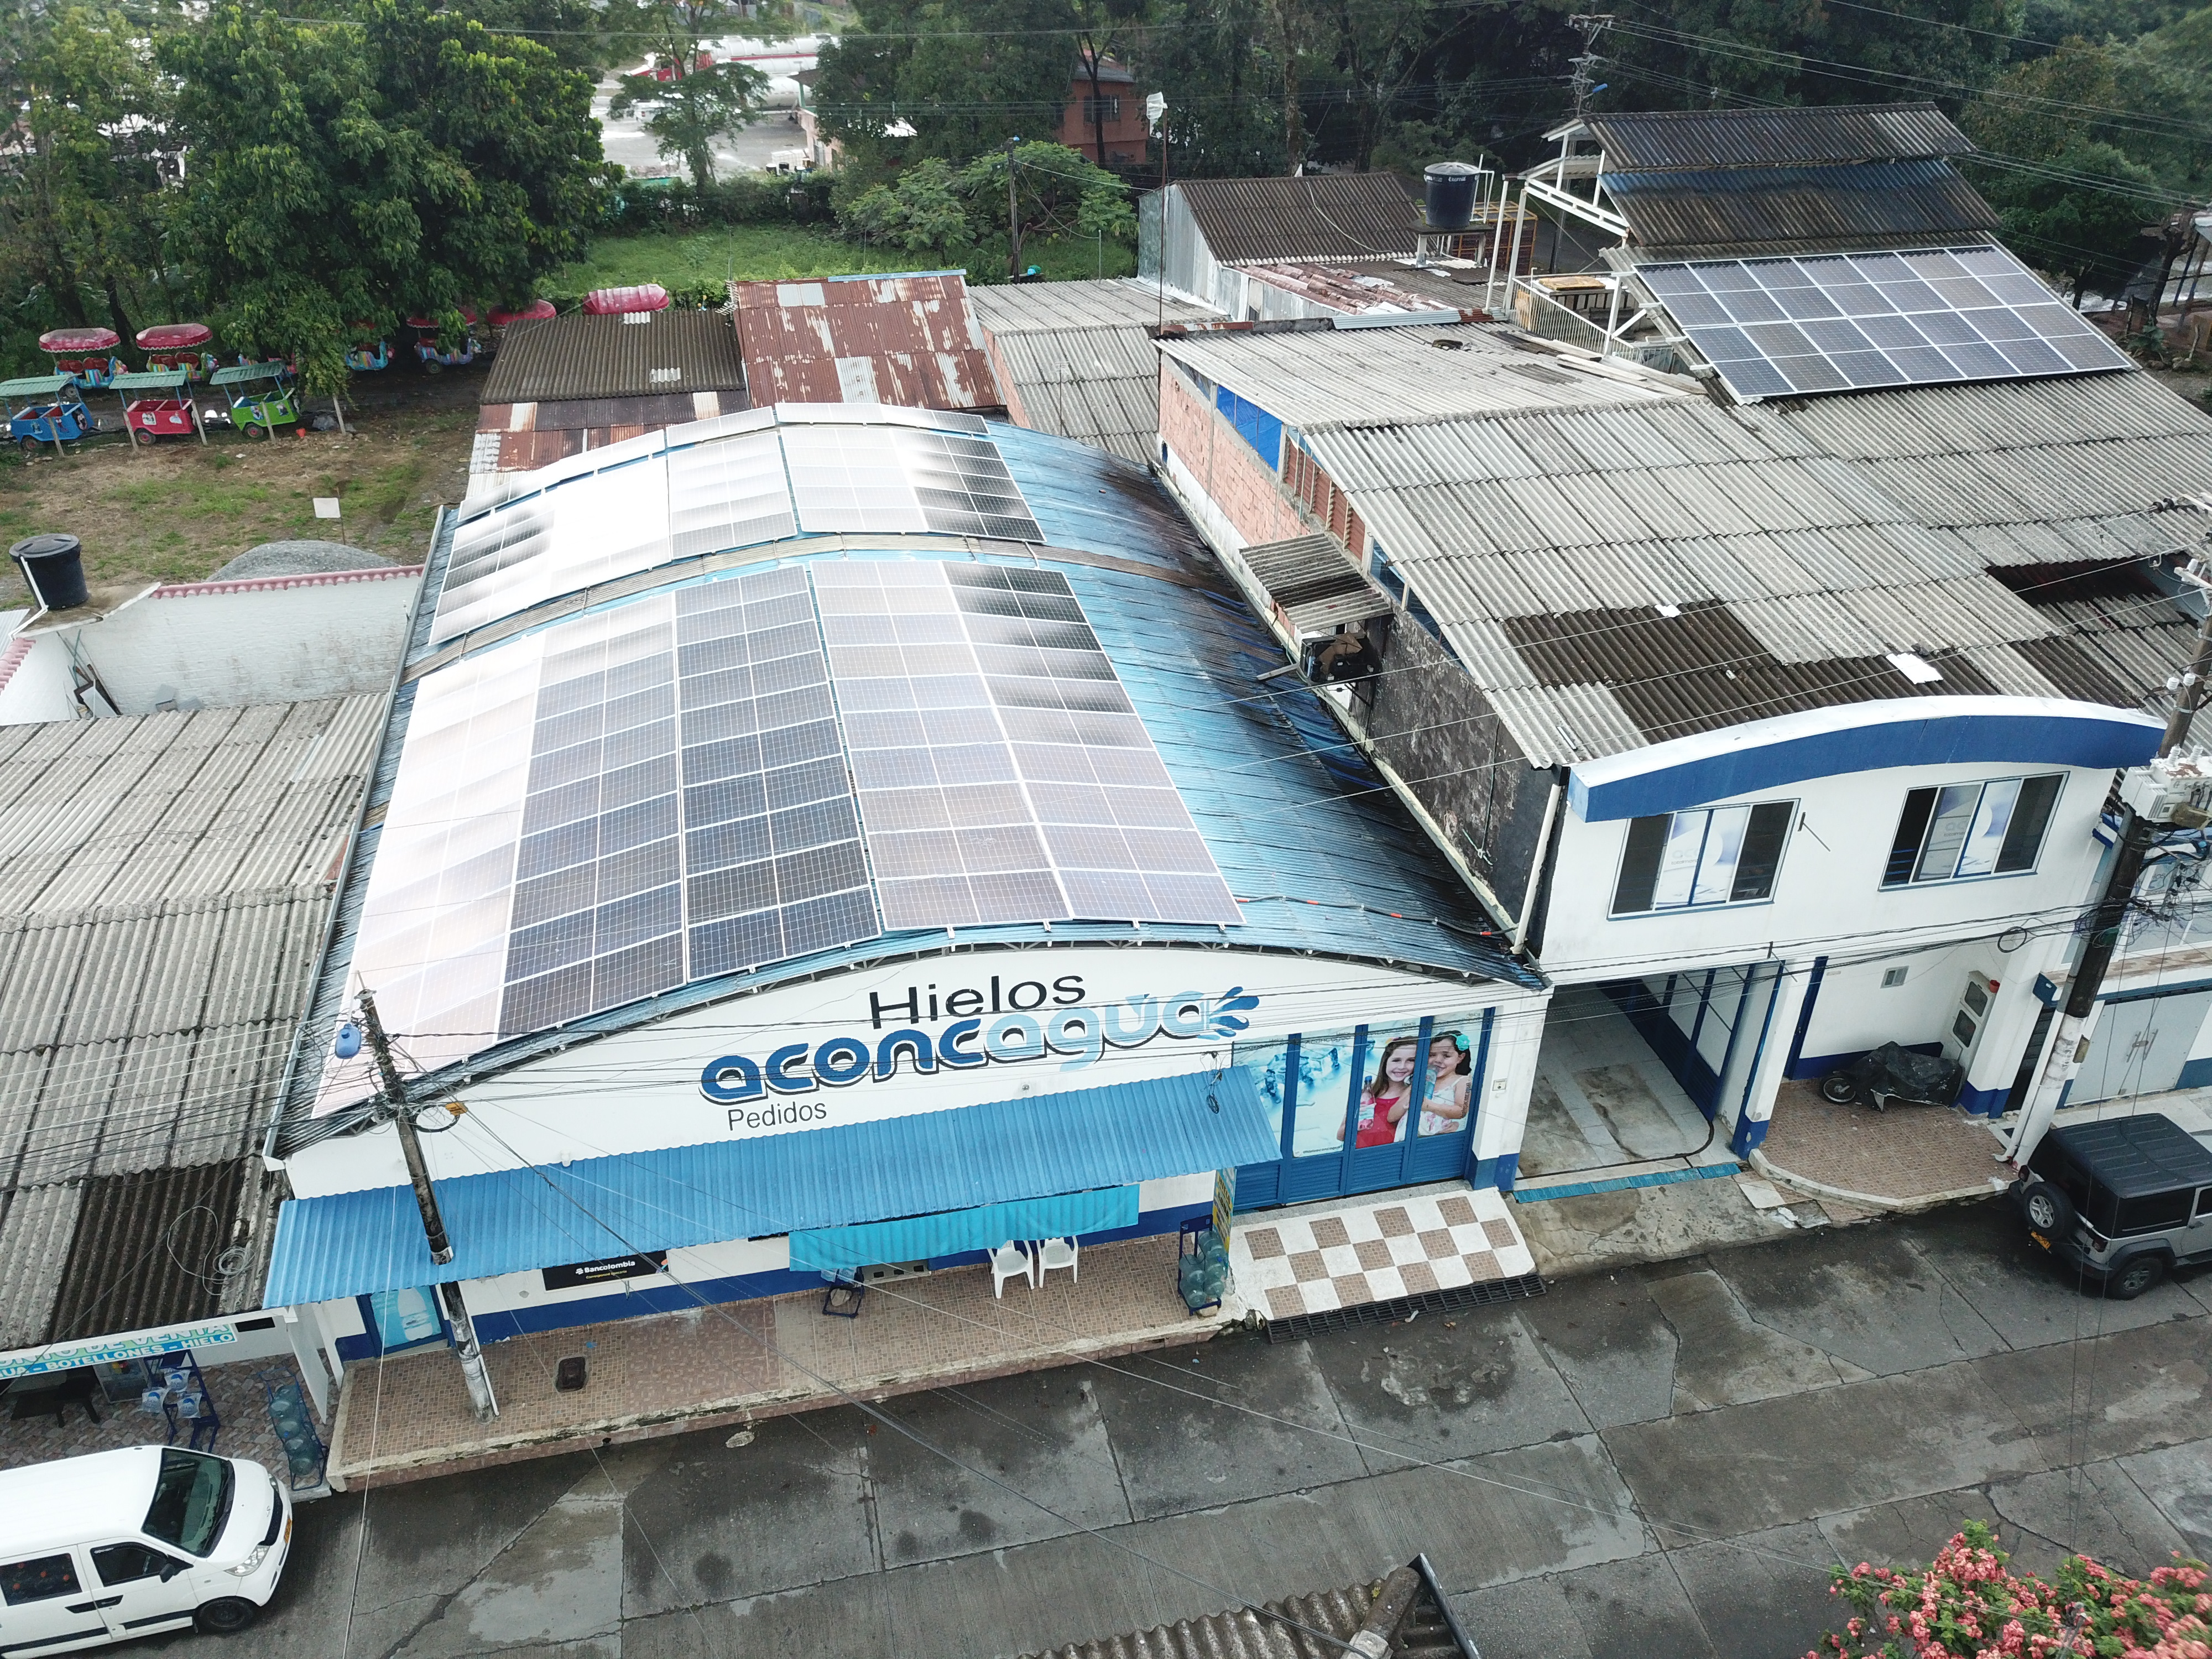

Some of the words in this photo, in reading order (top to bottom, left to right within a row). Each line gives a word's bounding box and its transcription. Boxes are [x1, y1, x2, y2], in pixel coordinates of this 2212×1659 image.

[869, 975, 1086, 1030] Hielos
[698, 989, 1212, 1106] aconcagua
[728, 1101, 827, 1131] Pedidos
[584, 1260, 635, 1273] Bancolombia
[48, 1345, 165, 1370] BOTELLONES
[182, 1333, 234, 1349] HIELO
